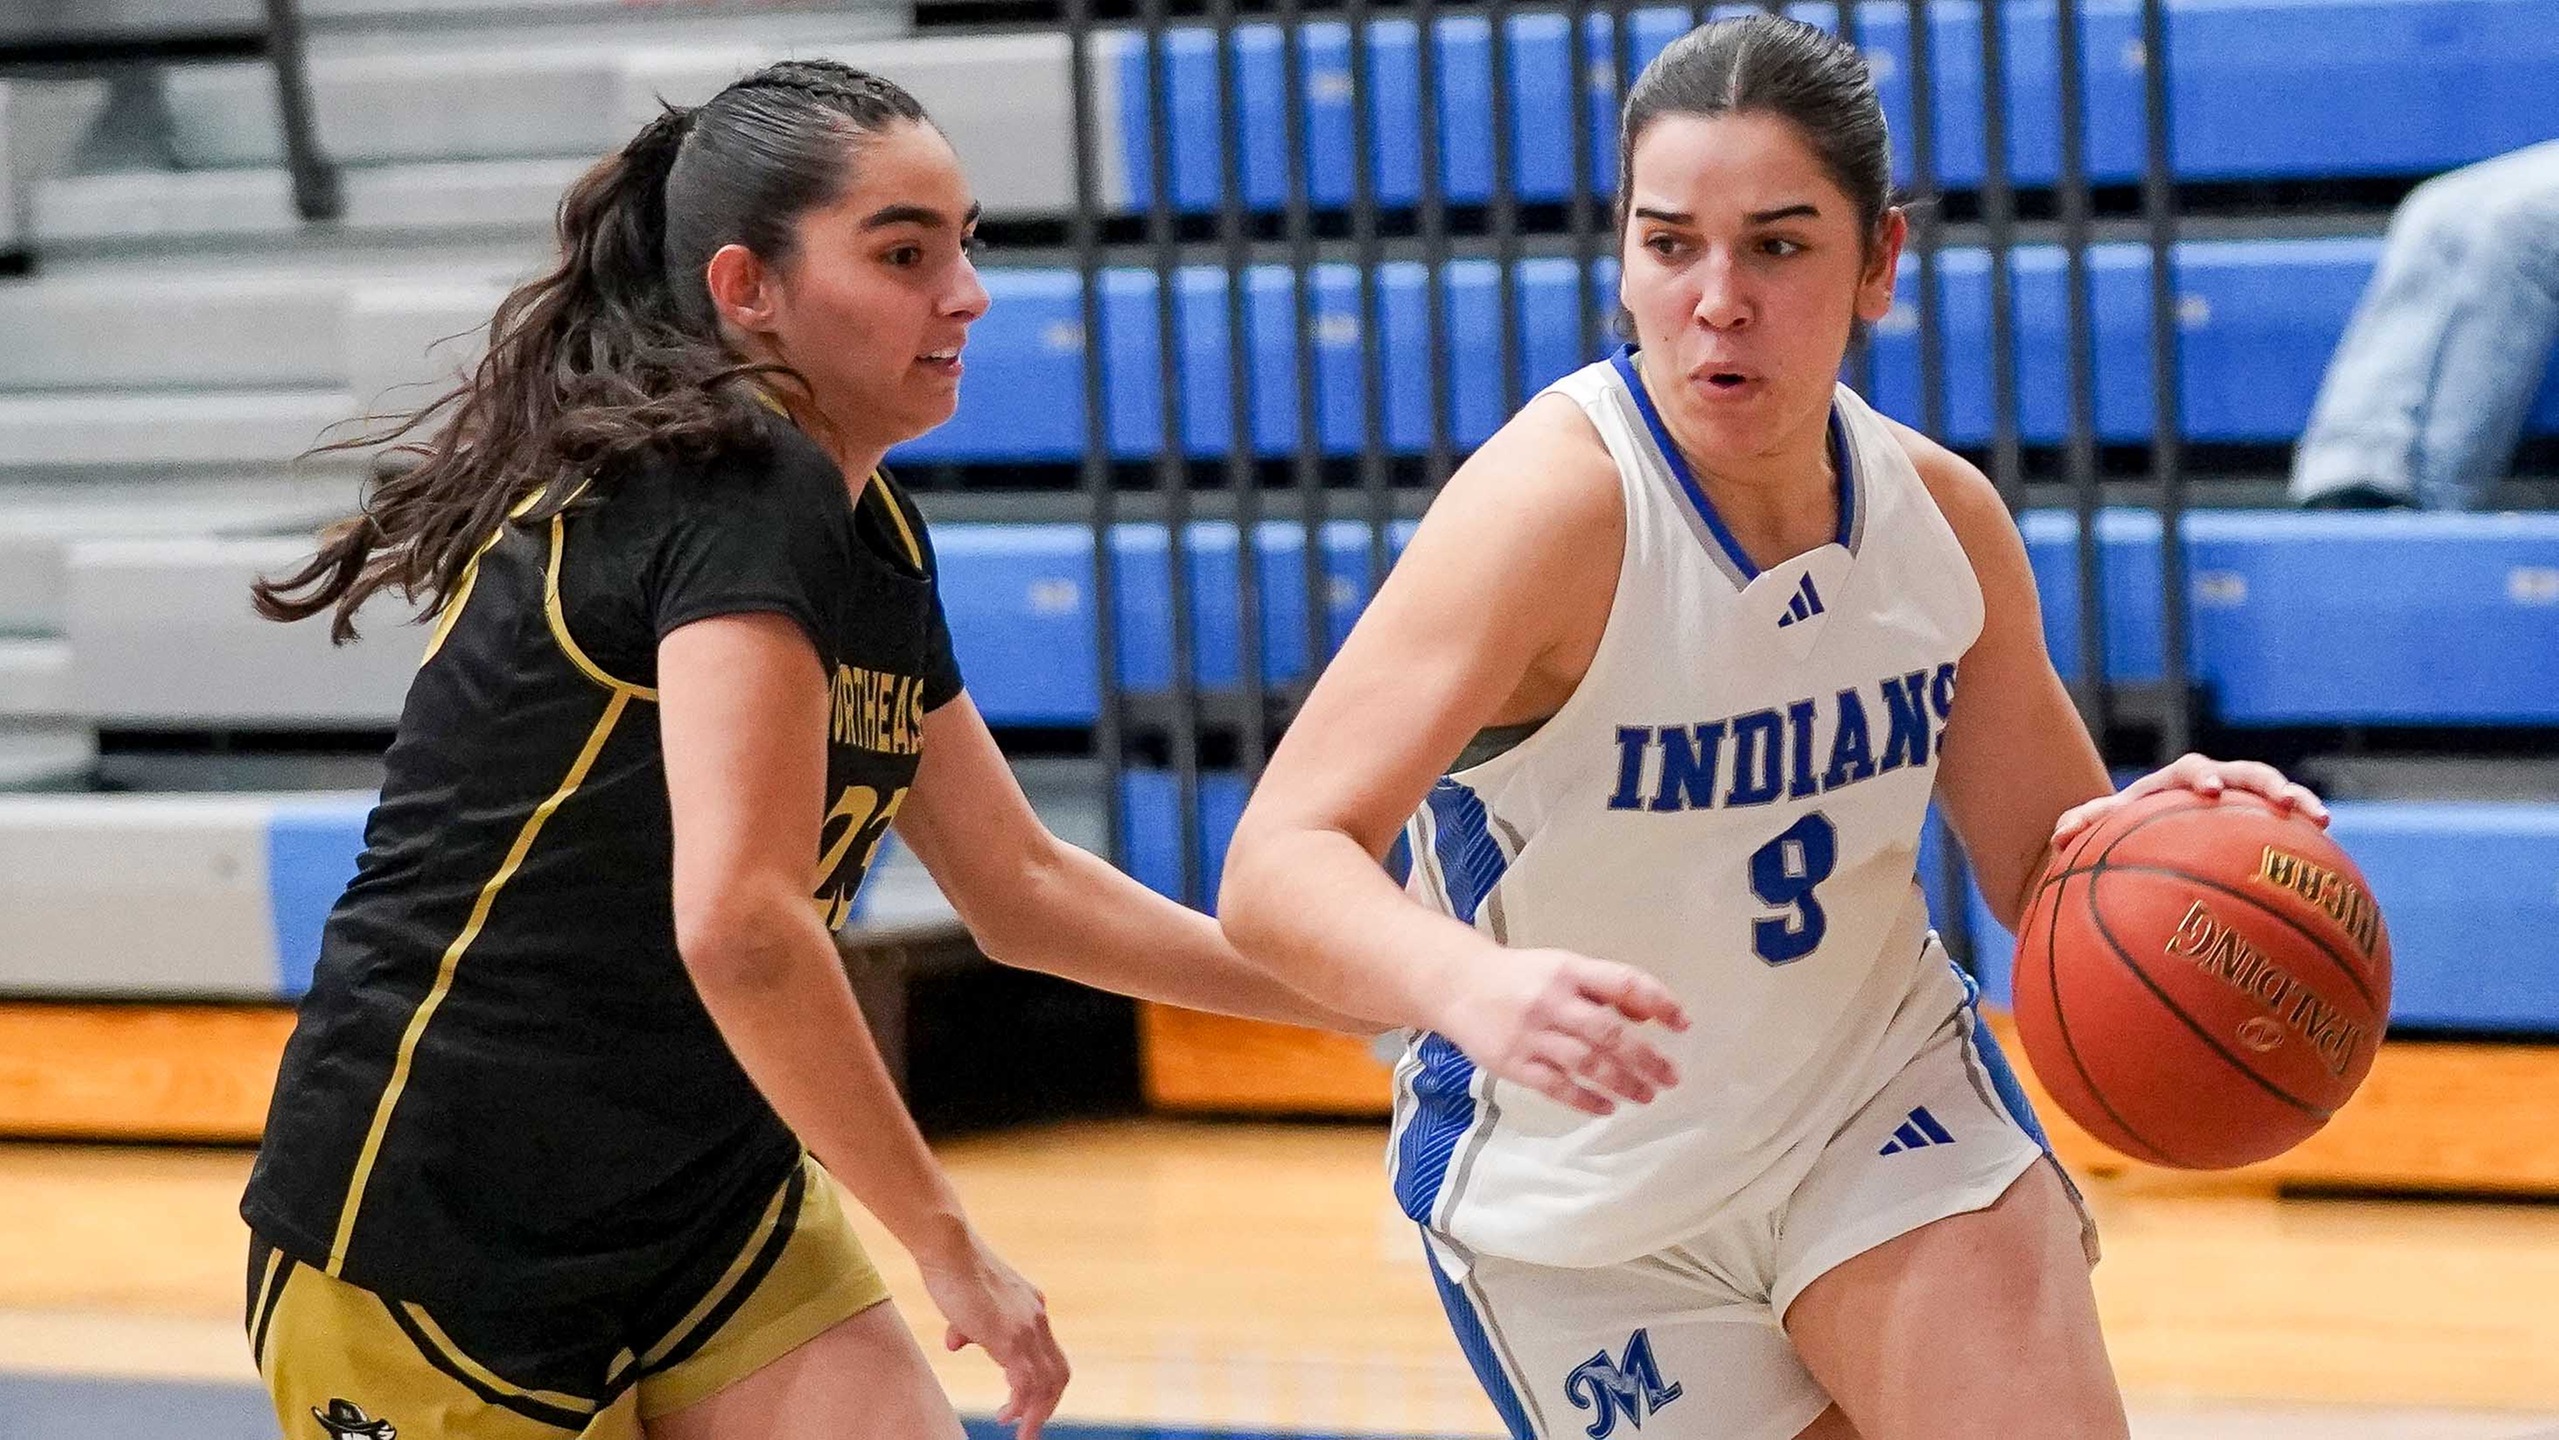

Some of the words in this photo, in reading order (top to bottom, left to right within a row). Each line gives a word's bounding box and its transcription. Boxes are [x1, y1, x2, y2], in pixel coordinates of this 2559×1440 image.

[828, 664, 923, 754] ORTHEAS
[1748, 810, 1838, 967] 9
[2163, 898, 2357, 1076] SPALDING
[1564, 1327, 1683, 1440] M
